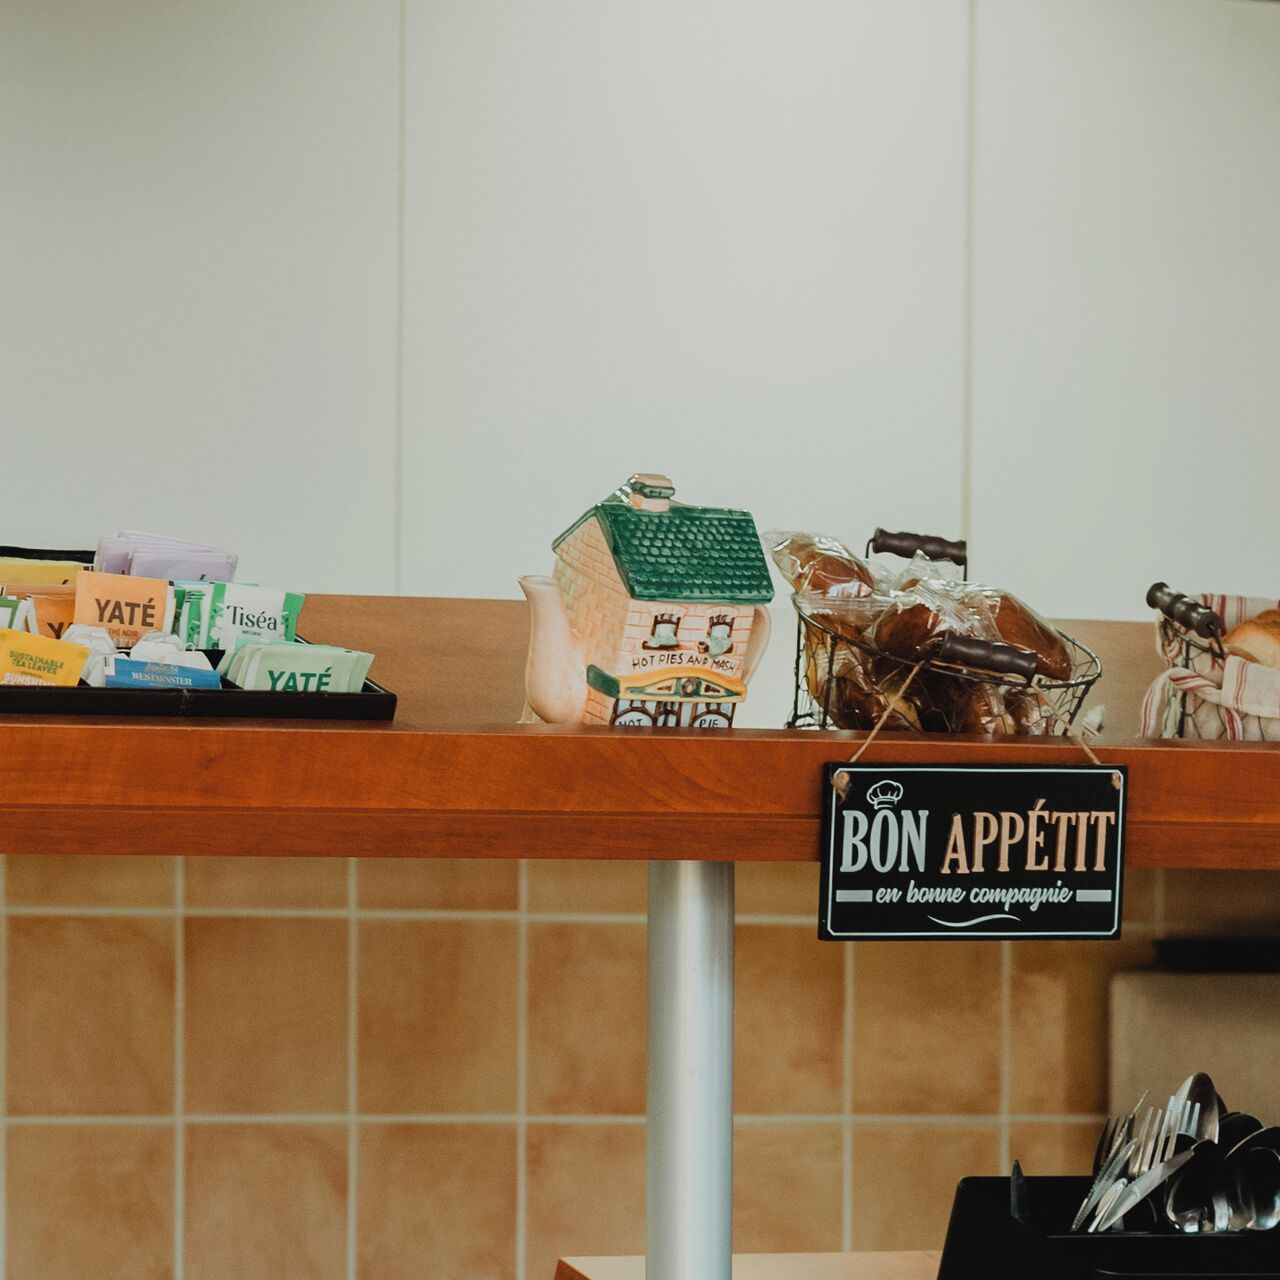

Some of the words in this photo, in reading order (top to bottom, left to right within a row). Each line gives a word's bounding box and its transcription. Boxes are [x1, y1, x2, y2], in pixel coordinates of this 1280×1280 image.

[95, 598, 155, 627] YATÉ
[226, 605, 278, 631] Tiséa
[9, 650, 64, 669] SUSTAINABLE
[632, 655, 655, 669] HOT
[659, 652, 684, 665] PIES
[686, 655, 708, 665] AND
[711, 659, 737, 671] MASH
[268, 667, 332, 693] YATÉ
[839, 809, 929, 873] BON
[940, 799, 1116, 874] APPÉTIT
[875, 887, 903, 903] en
[906, 880, 967, 903] bonne
[970, 880, 1073, 912] compagnie
